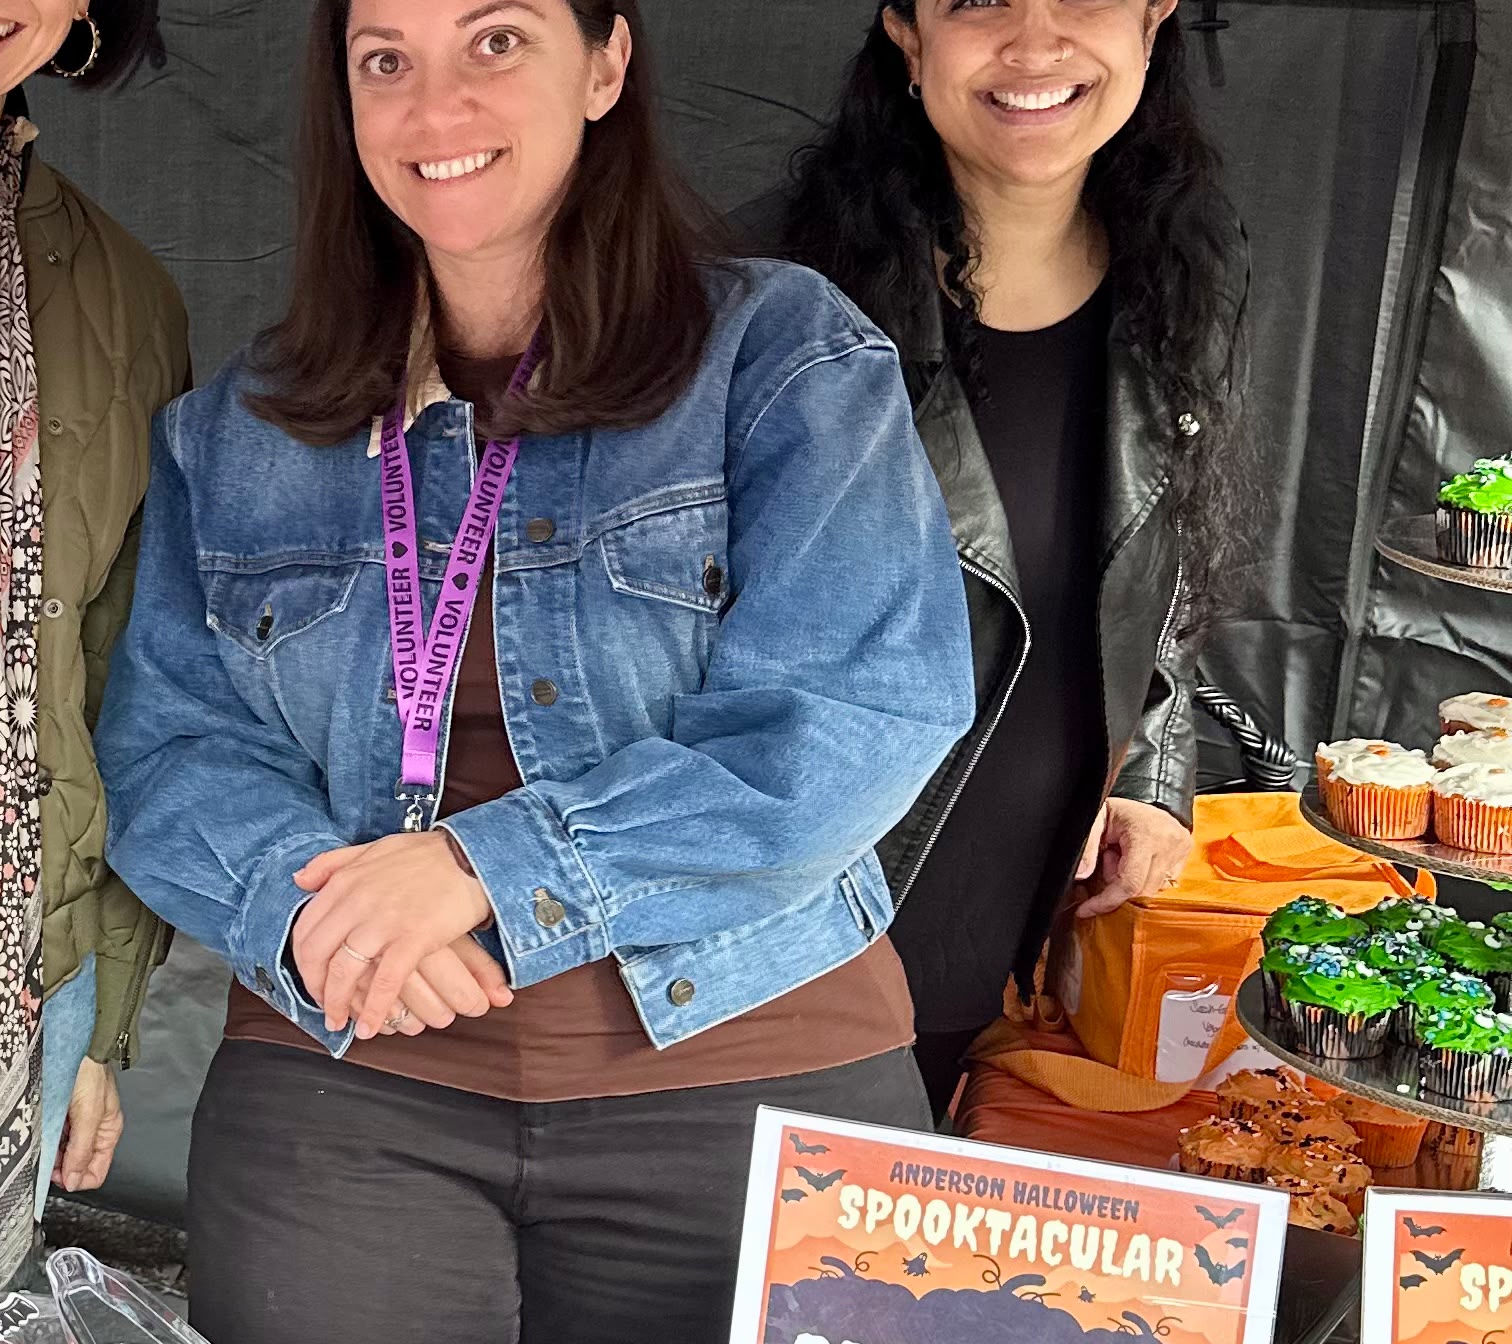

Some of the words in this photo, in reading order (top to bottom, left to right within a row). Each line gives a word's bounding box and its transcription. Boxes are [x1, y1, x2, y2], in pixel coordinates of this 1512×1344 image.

[383, 421, 407, 533] VOLUNTEE
[456, 441, 510, 565] VOLUNTEER
[391, 567, 419, 700] VOLUNTEER
[413, 599, 464, 732] VOLUNTEER
[838, 1184, 1183, 1287] SPOOKTACULAR
[890, 1161, 1006, 1200] ANDERSON
[1013, 1181, 1140, 1223] HALLOWEEN
